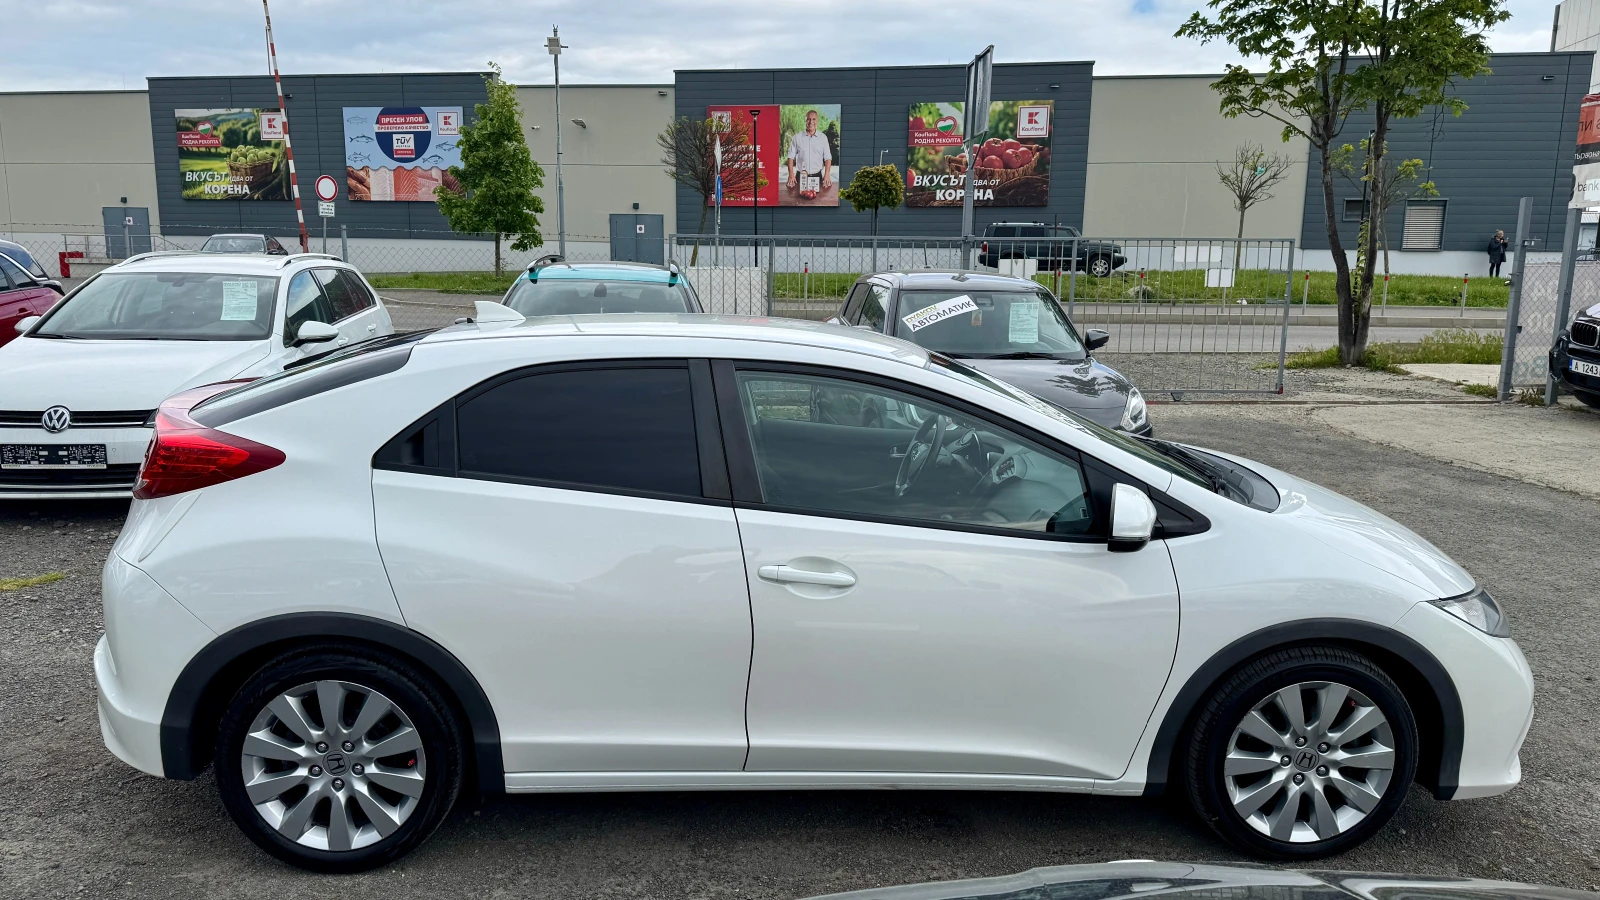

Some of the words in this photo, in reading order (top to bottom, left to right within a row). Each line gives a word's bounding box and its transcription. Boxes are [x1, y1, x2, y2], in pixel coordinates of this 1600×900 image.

[185, 171, 228, 182] ВКУСЪТ
[913, 174, 967, 187] ВКУСЪТ
[204, 184, 251, 195] КОРЕНА
[1577, 181, 1599, 192] bank
[935, 188, 995, 201] КОРНА
[911, 300, 975, 331] АВТОМАТИК
[1582, 363, 1599, 376] 1243
